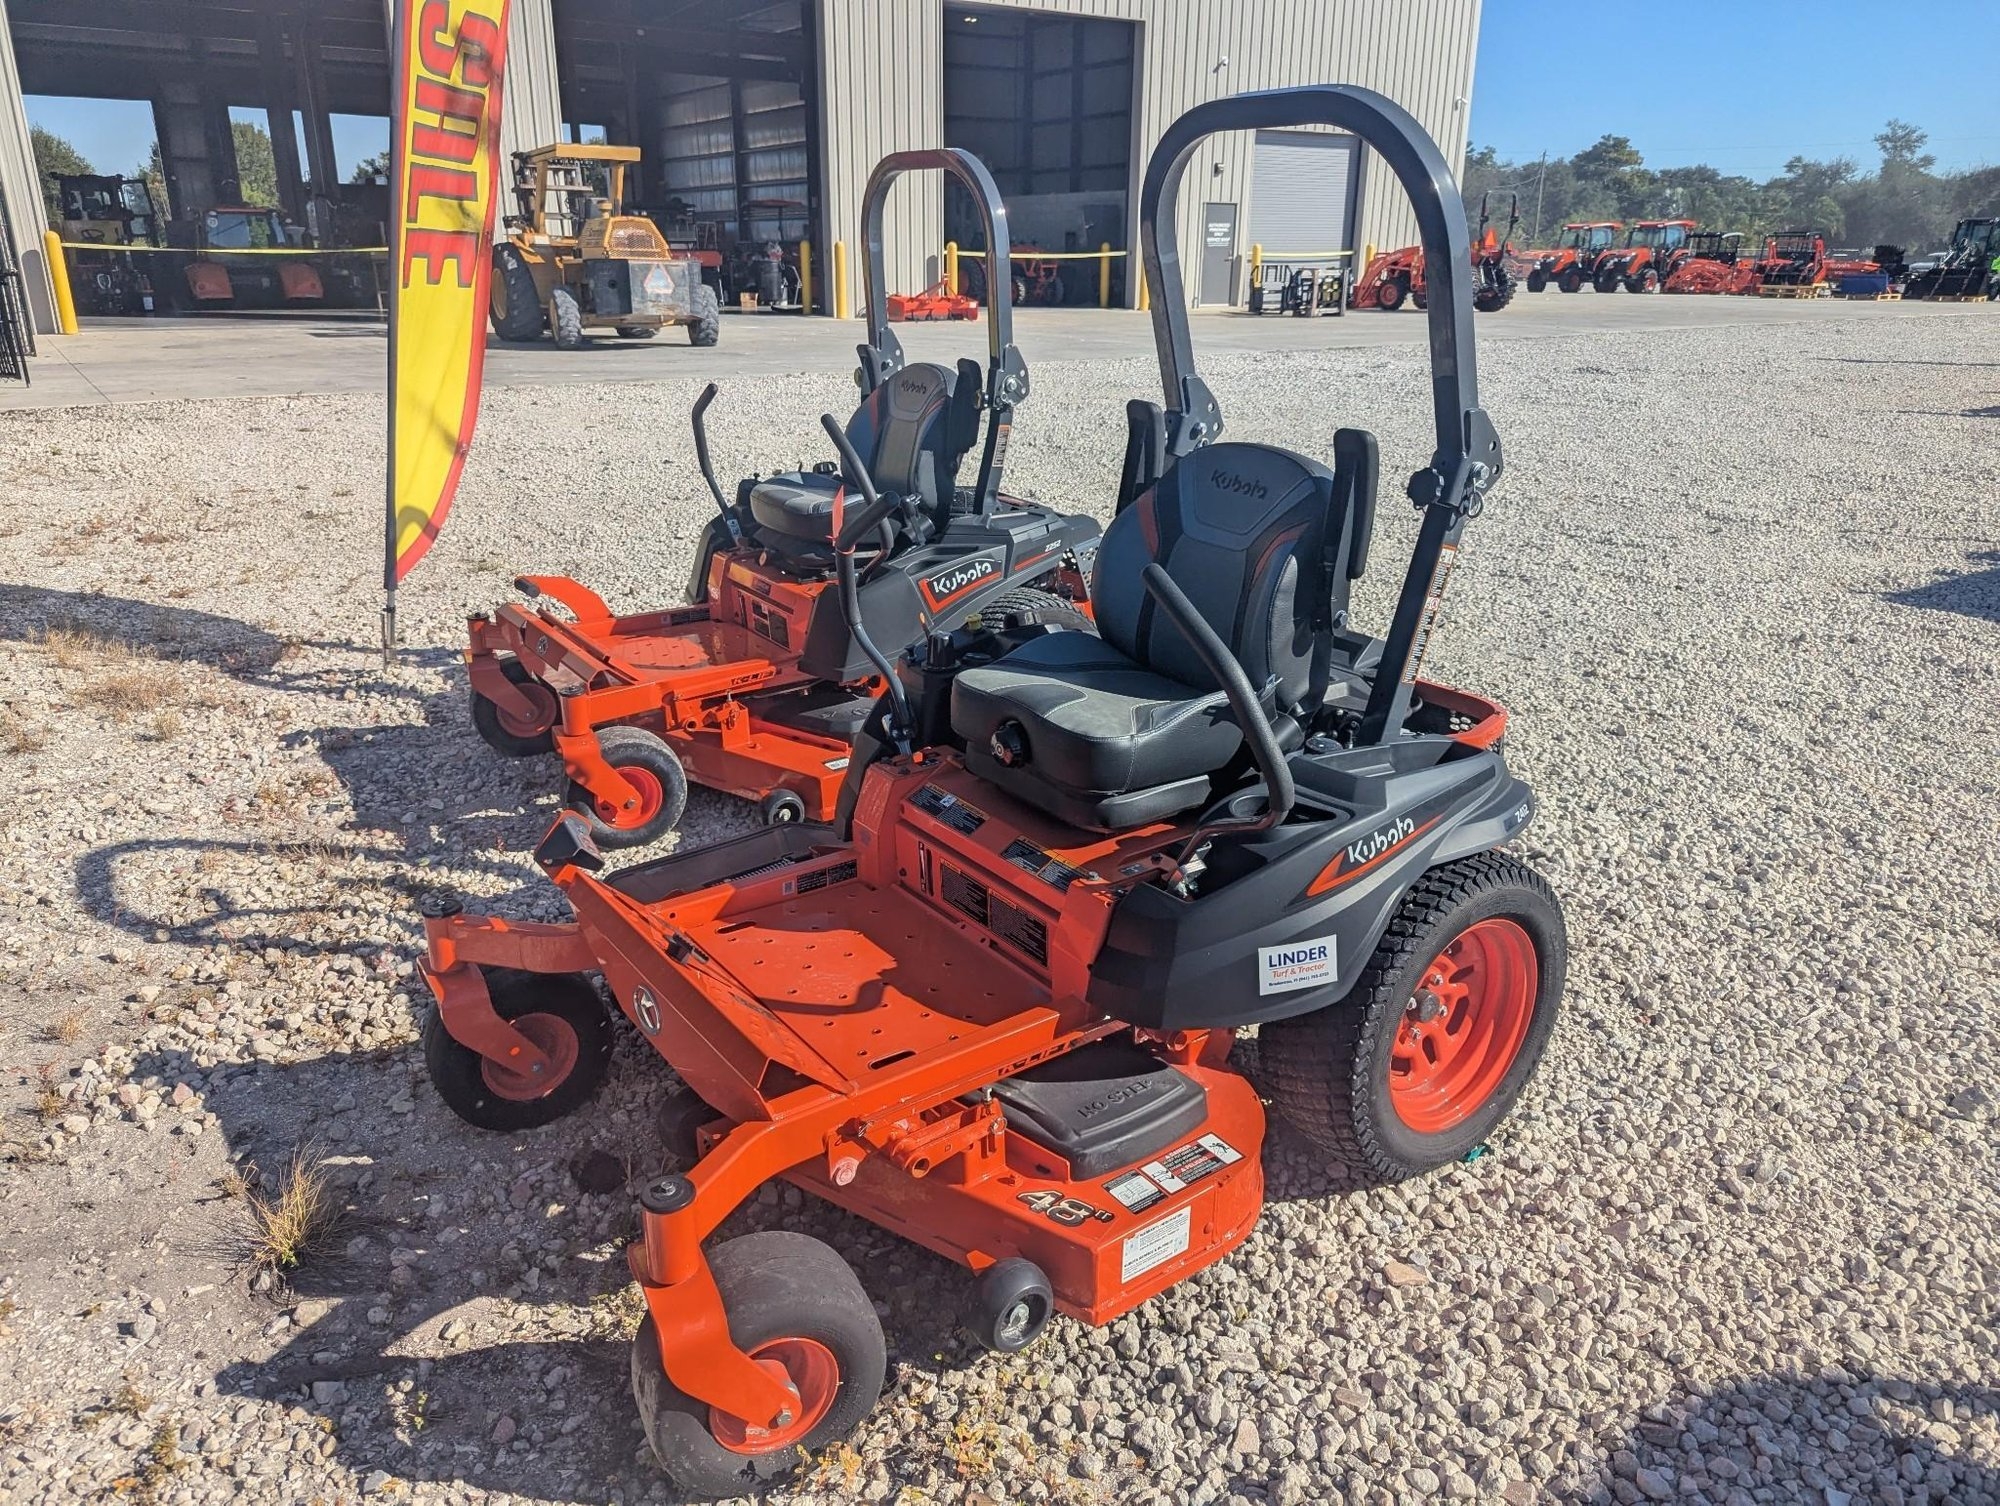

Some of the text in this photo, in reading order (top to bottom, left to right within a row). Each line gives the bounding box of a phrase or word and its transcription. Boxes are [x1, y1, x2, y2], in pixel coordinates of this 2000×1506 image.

[402, 0, 498, 288] SALE
[1211, 469, 1268, 500] Kubota
[933, 561, 992, 594] Kubota
[1347, 817, 1415, 864] Kubota
[1268, 945, 1328, 968] LINDER
[1273, 962, 1326, 978] Turf & Tractor
[1077, 1078, 1154, 1120] NO STEP
